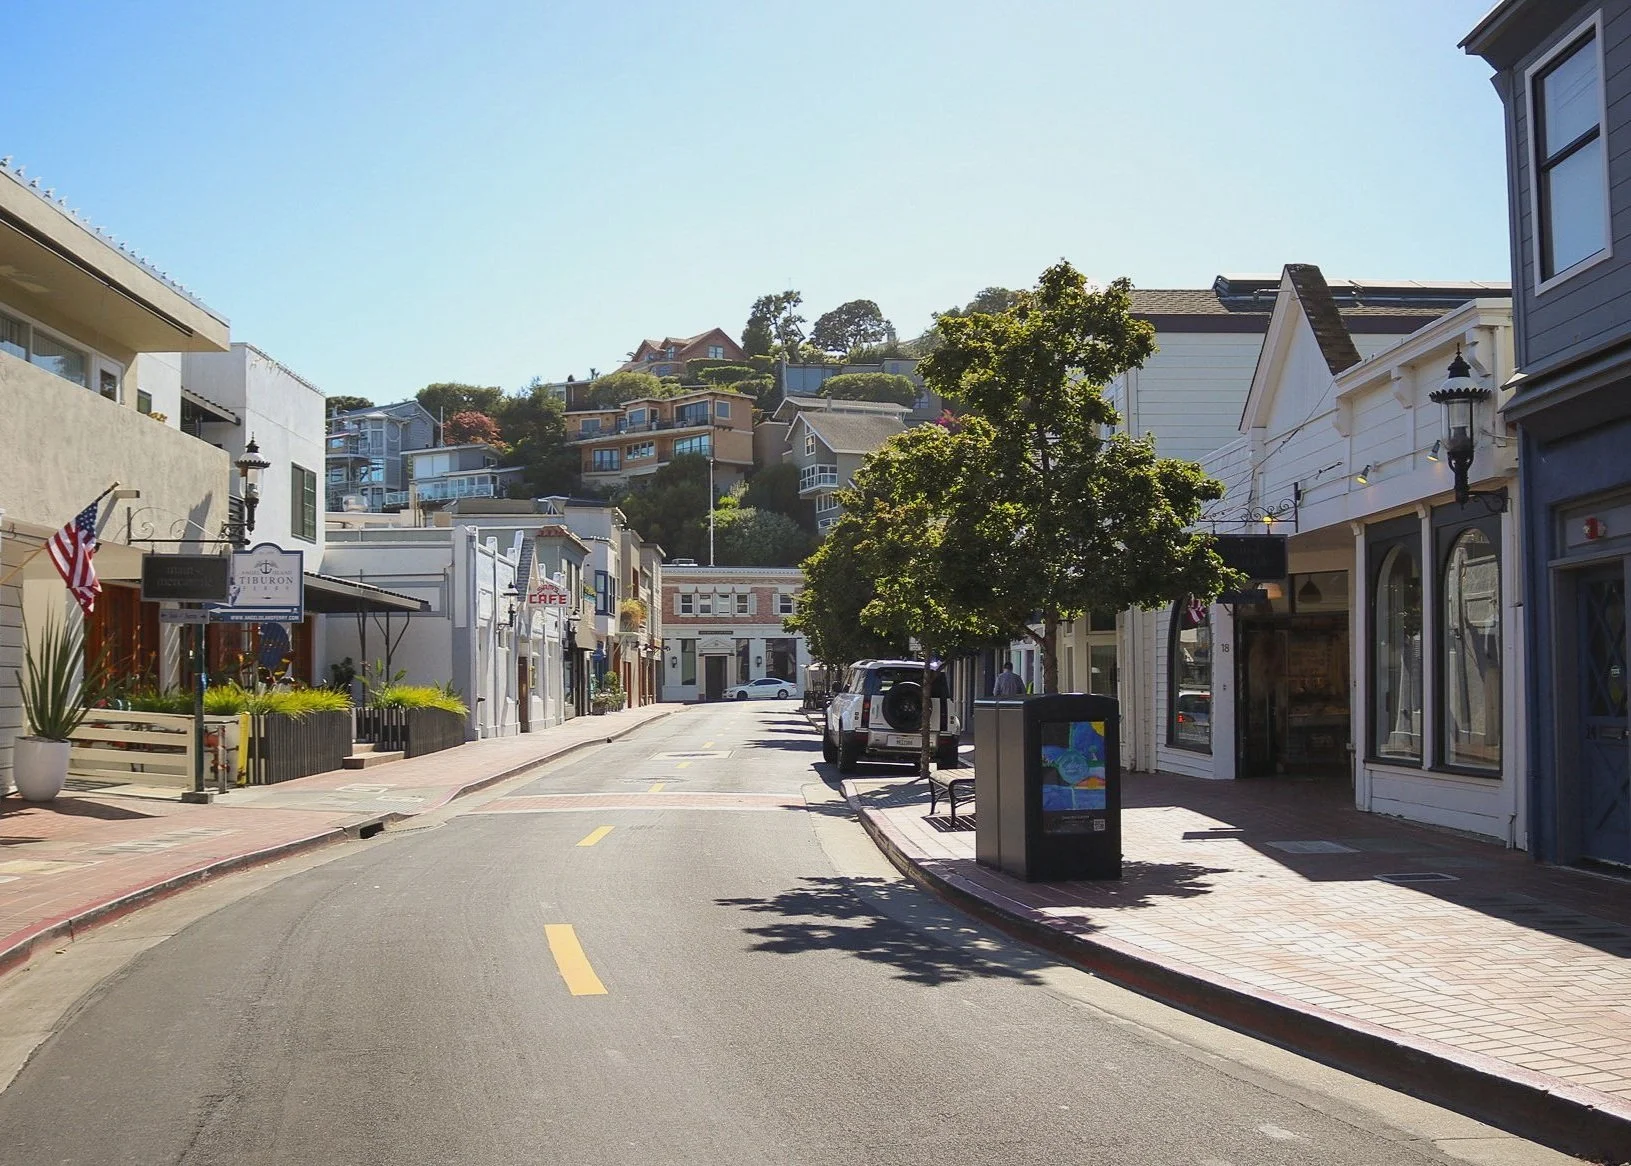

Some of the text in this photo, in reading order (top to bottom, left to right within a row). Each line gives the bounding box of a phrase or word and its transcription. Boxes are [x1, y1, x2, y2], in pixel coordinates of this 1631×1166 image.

[239, 576, 294, 585] TIBURON
[529, 594, 566, 604] CAFE
[1221, 643, 1230, 653] 18
